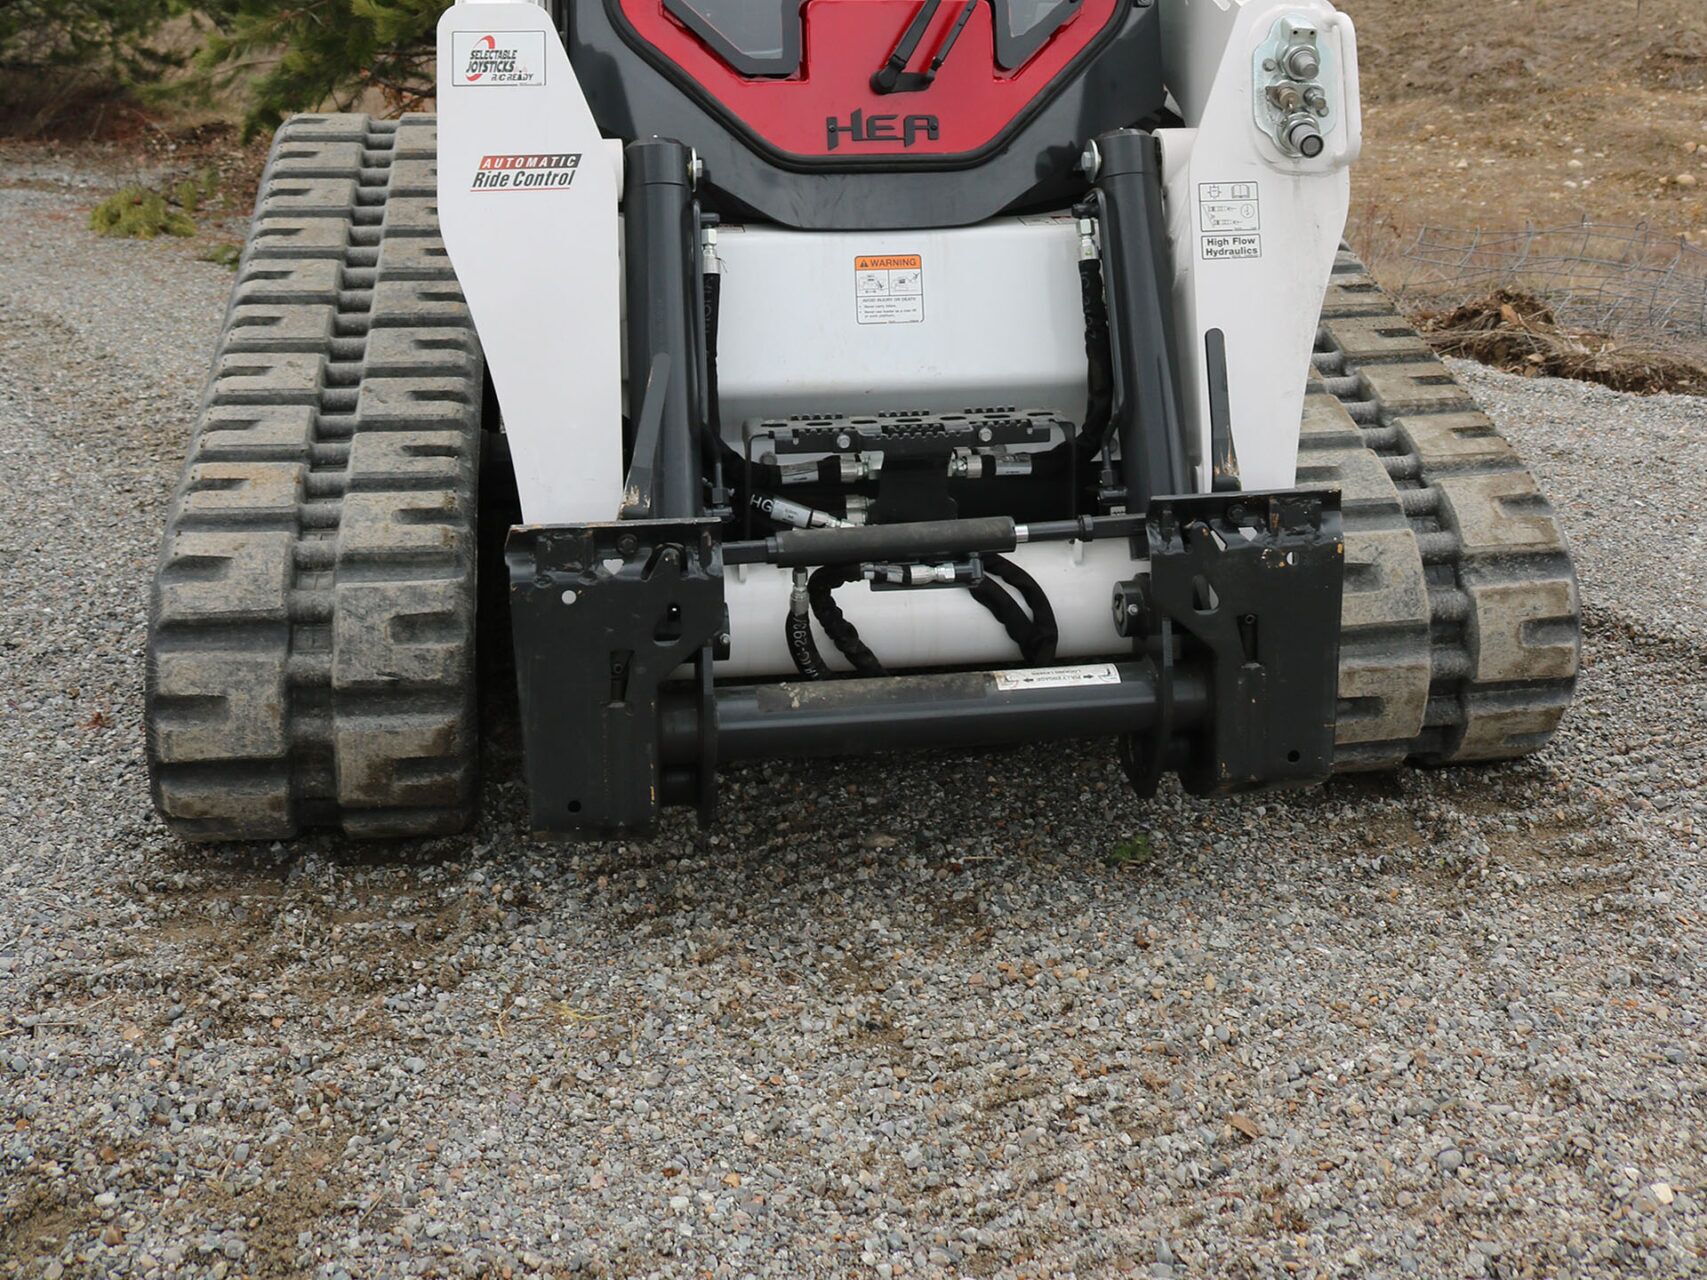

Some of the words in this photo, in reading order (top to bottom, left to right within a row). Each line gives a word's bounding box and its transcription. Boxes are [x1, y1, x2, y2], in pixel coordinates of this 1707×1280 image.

[470, 49, 518, 60] SELECTABLE
[466, 60, 515, 73] JOYSTICKS
[507, 73, 534, 81] READY
[482, 156, 577, 168] AUTOMATIC
[472, 170, 510, 188] Ride
[513, 169, 576, 187] Control
[1206, 238, 1229, 248] High
[1232, 237, 1256, 245] Flow
[1206, 247, 1258, 257] Hydraulics
[870, 258, 916, 267] WARNING
